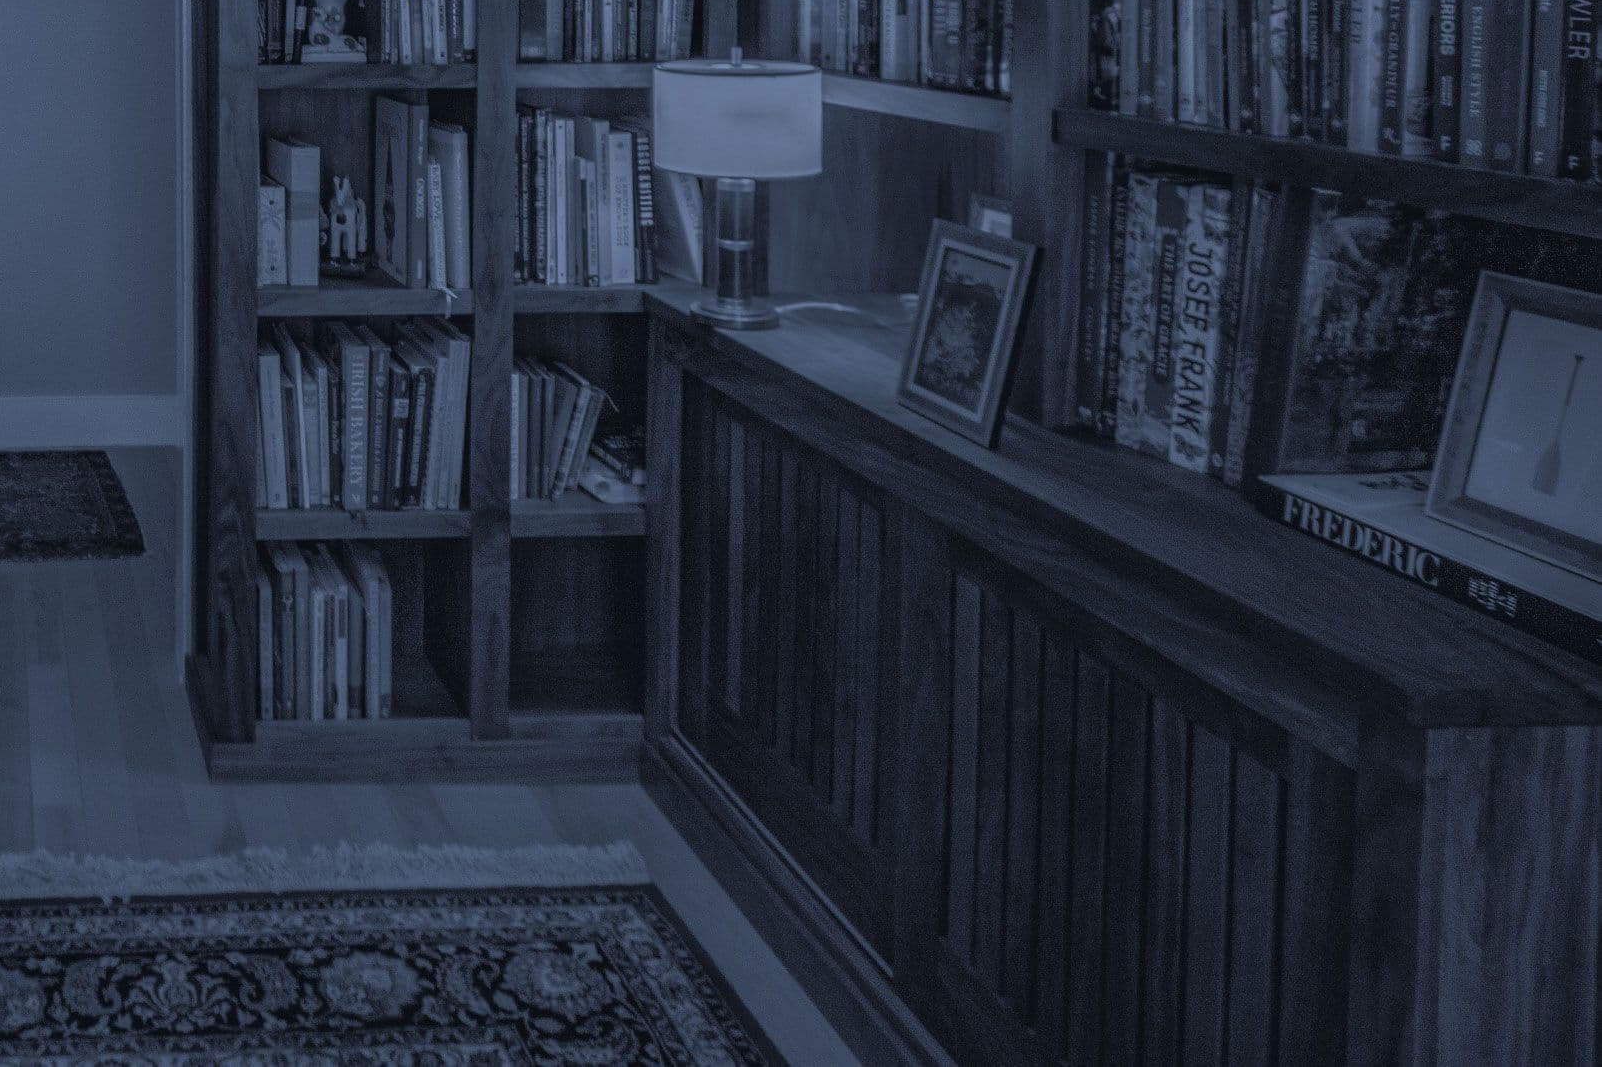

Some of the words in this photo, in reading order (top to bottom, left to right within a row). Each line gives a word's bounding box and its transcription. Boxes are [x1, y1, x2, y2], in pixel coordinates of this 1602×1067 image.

[1308, 16, 1318, 61] HOMES
[1470, 6, 1483, 68] ENGLISH
[1383, 32, 1400, 109] GRANDEUR
[1468, 72, 1482, 118] STYLE
[1162, 243, 1175, 271] THE
[1160, 273, 1173, 303] ART
[1182, 242, 1214, 334] JOSEF
[1159, 306, 1172, 324] OF
[1155, 326, 1171, 378] GRACIE
[351, 361, 365, 410] IRISH
[1176, 339, 1206, 436] FRANK
[349, 416, 364, 489] BAKERY
[1282, 493, 1440, 588] FREDERIC
